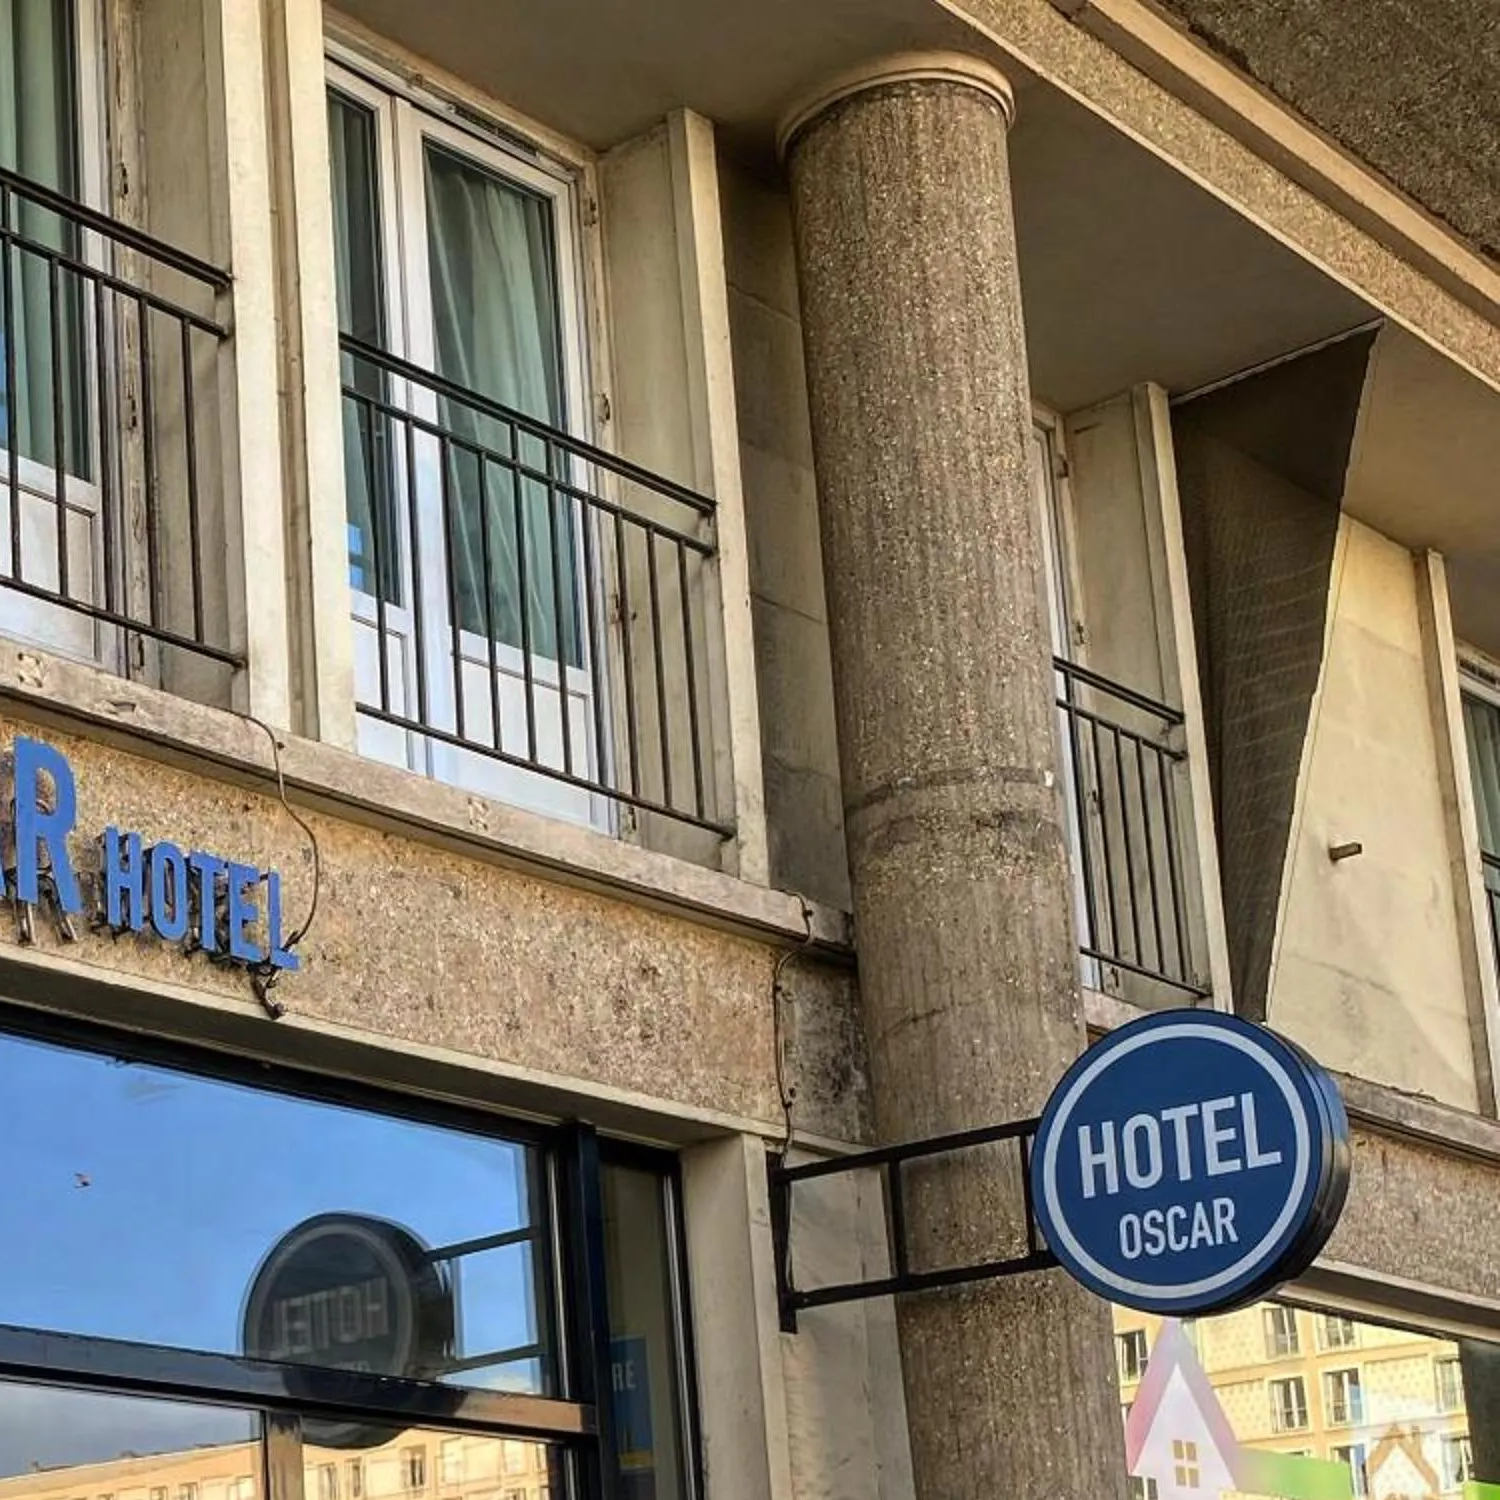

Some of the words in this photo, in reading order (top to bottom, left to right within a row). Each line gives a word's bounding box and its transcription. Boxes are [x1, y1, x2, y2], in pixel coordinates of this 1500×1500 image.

[103, 825, 301, 971] HOTEL
[1077, 1092, 1282, 1199] HOTEL
[1119, 1197, 1239, 1260] OSCAR
